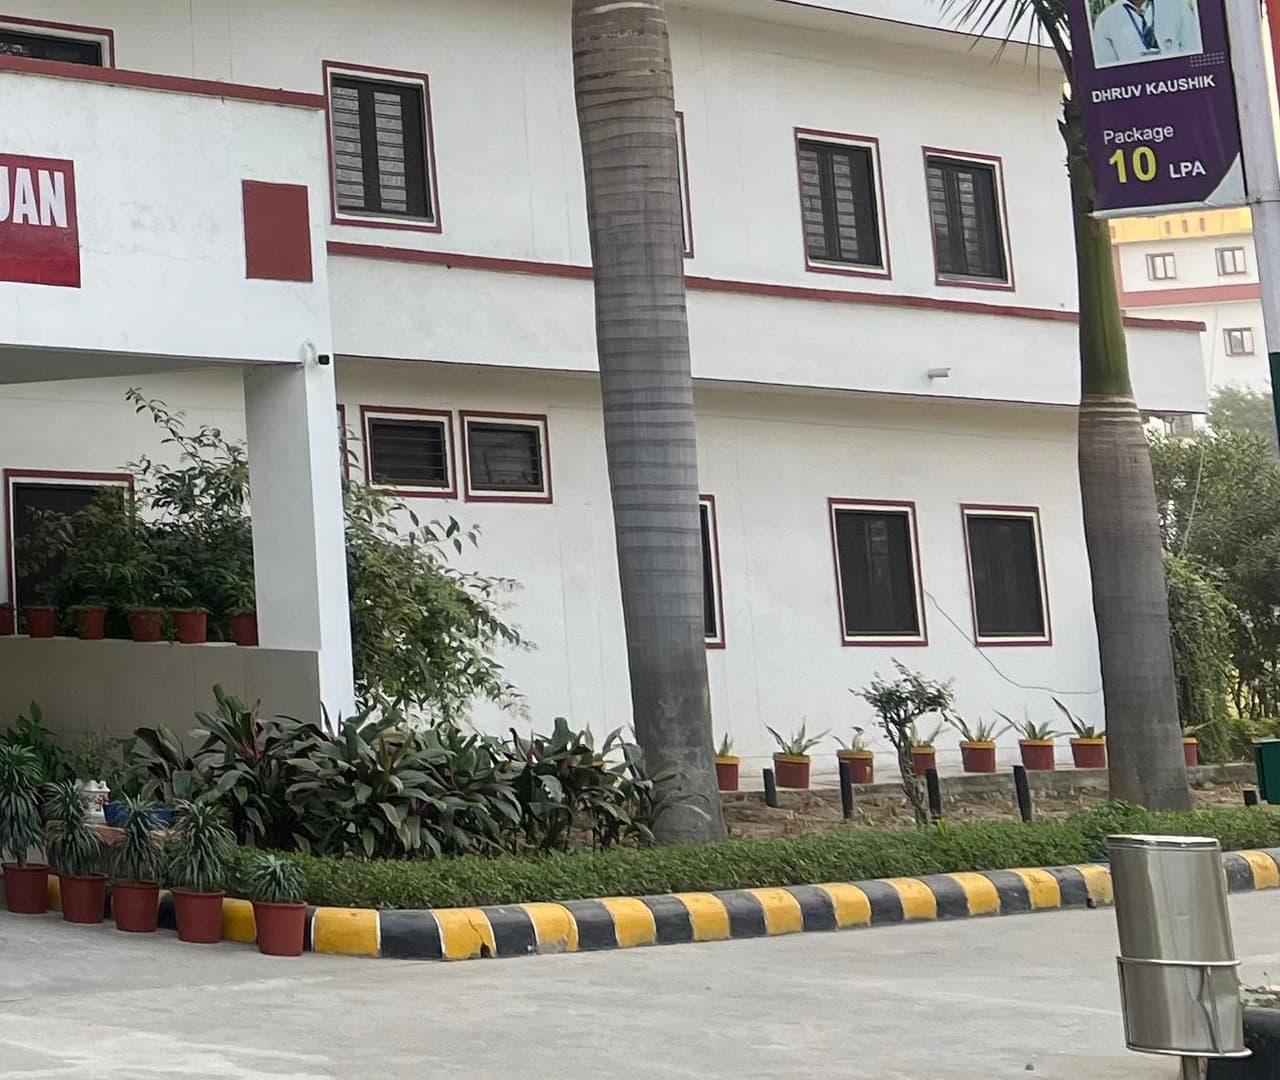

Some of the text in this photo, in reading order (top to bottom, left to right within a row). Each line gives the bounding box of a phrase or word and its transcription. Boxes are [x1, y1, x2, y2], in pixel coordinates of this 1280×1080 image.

[1091, 74, 1215, 103] DHRUV KAUSHIK
[1103, 126, 1174, 145] Package
[1109, 146, 1206, 183] 10 LPA
